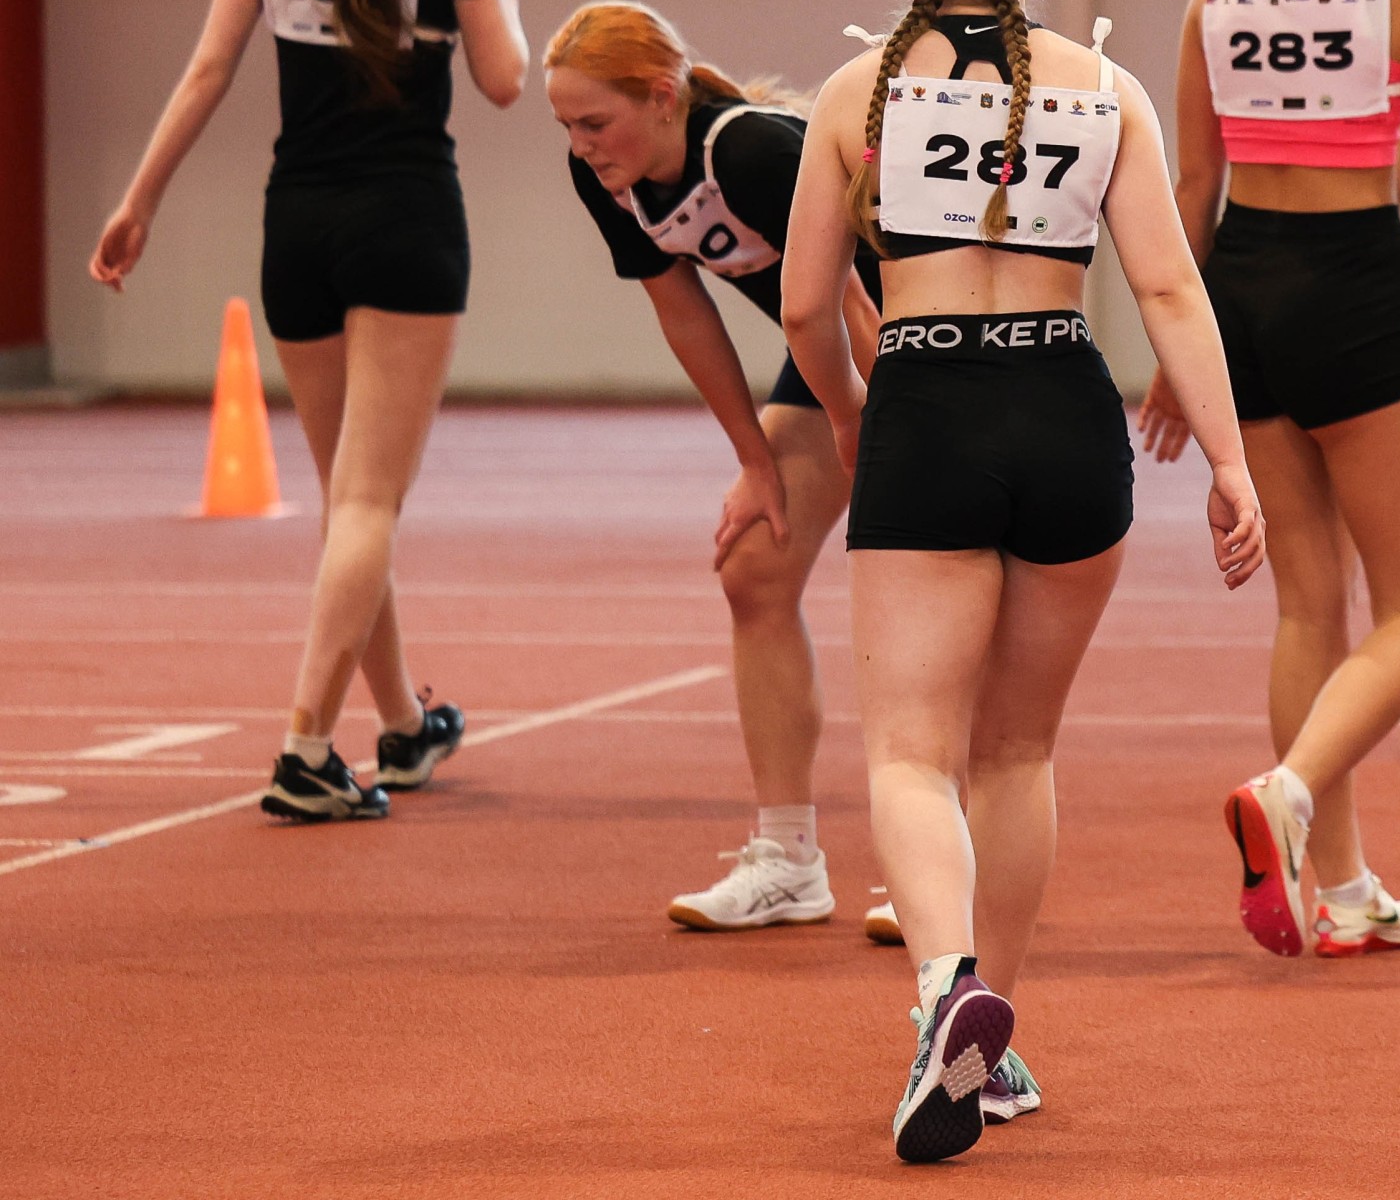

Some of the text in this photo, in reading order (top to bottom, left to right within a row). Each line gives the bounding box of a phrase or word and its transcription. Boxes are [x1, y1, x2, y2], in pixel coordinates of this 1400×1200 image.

[1229, 30, 1354, 73] 283
[923, 133, 1081, 190] 287
[943, 212, 976, 224] OZON
